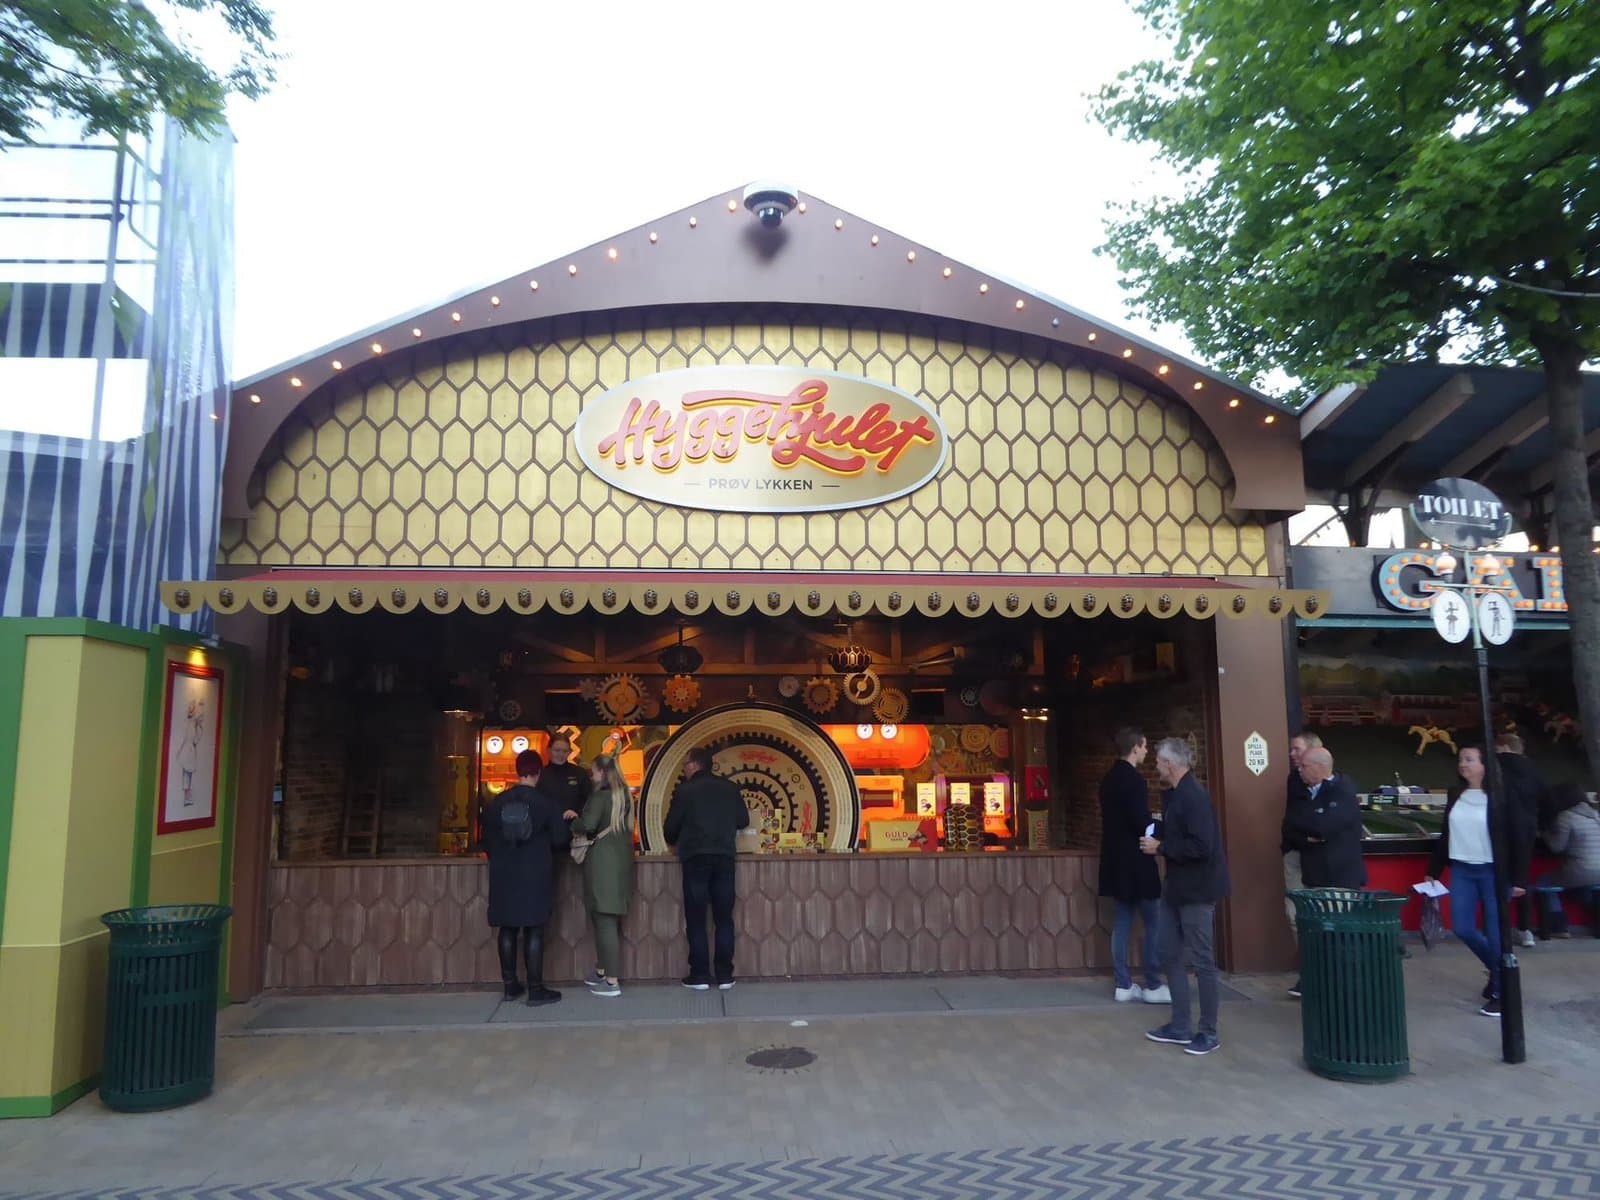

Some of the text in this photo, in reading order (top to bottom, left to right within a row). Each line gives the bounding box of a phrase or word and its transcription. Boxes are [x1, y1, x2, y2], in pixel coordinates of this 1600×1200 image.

[597, 379, 936, 475] Hyggehjulet
[708, 478, 813, 490] PRØV LYKKEN
[1418, 494, 1502, 520] TOILET
